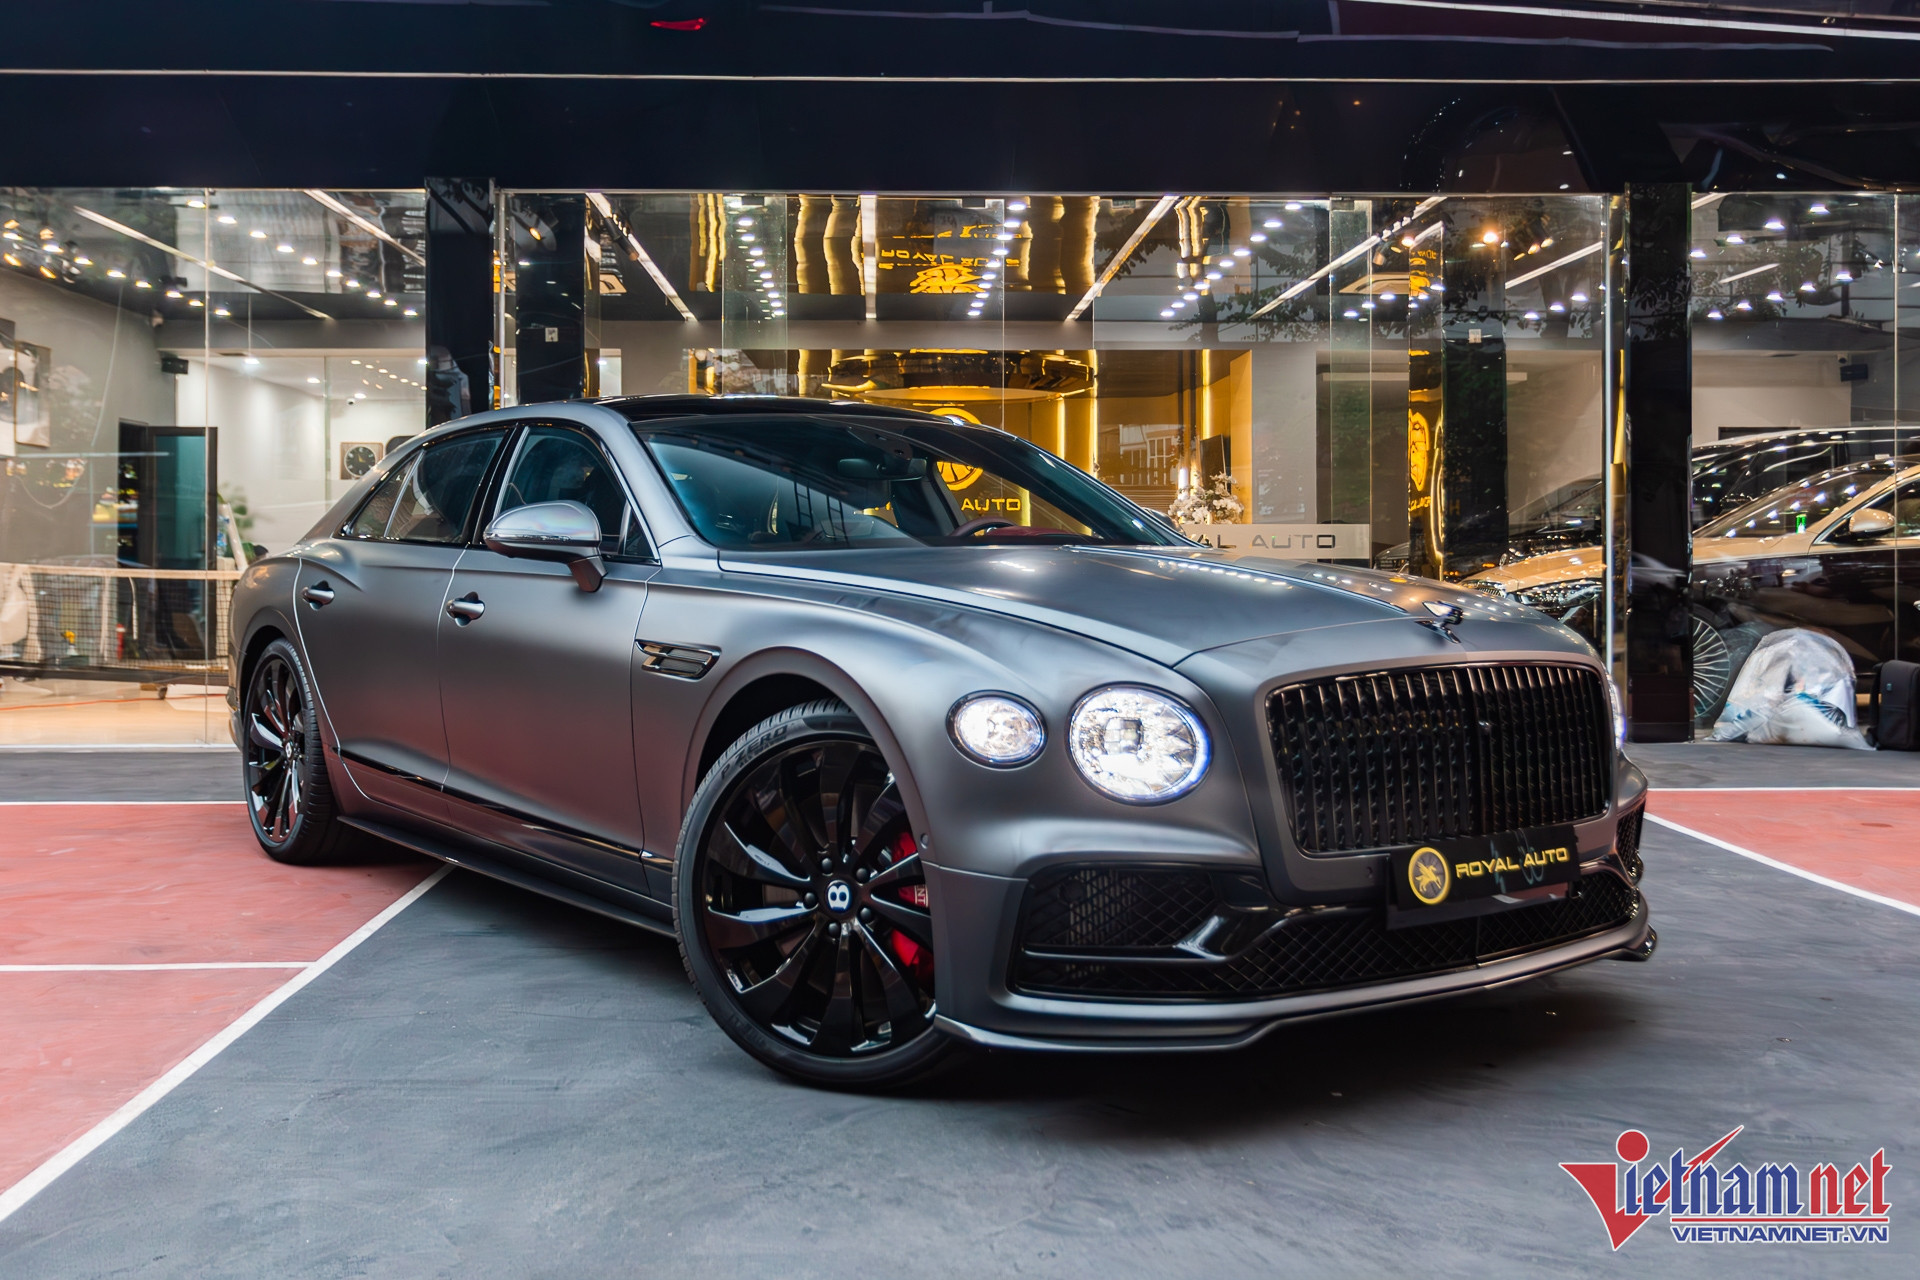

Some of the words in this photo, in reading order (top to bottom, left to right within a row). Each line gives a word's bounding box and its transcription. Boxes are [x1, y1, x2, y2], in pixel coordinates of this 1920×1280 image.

[961, 498, 1021, 512] AUTO
[1251, 534, 1336, 549] AUTO
[1455, 855, 1520, 879] ROYAL
[1523, 847, 1570, 868] AUTO
